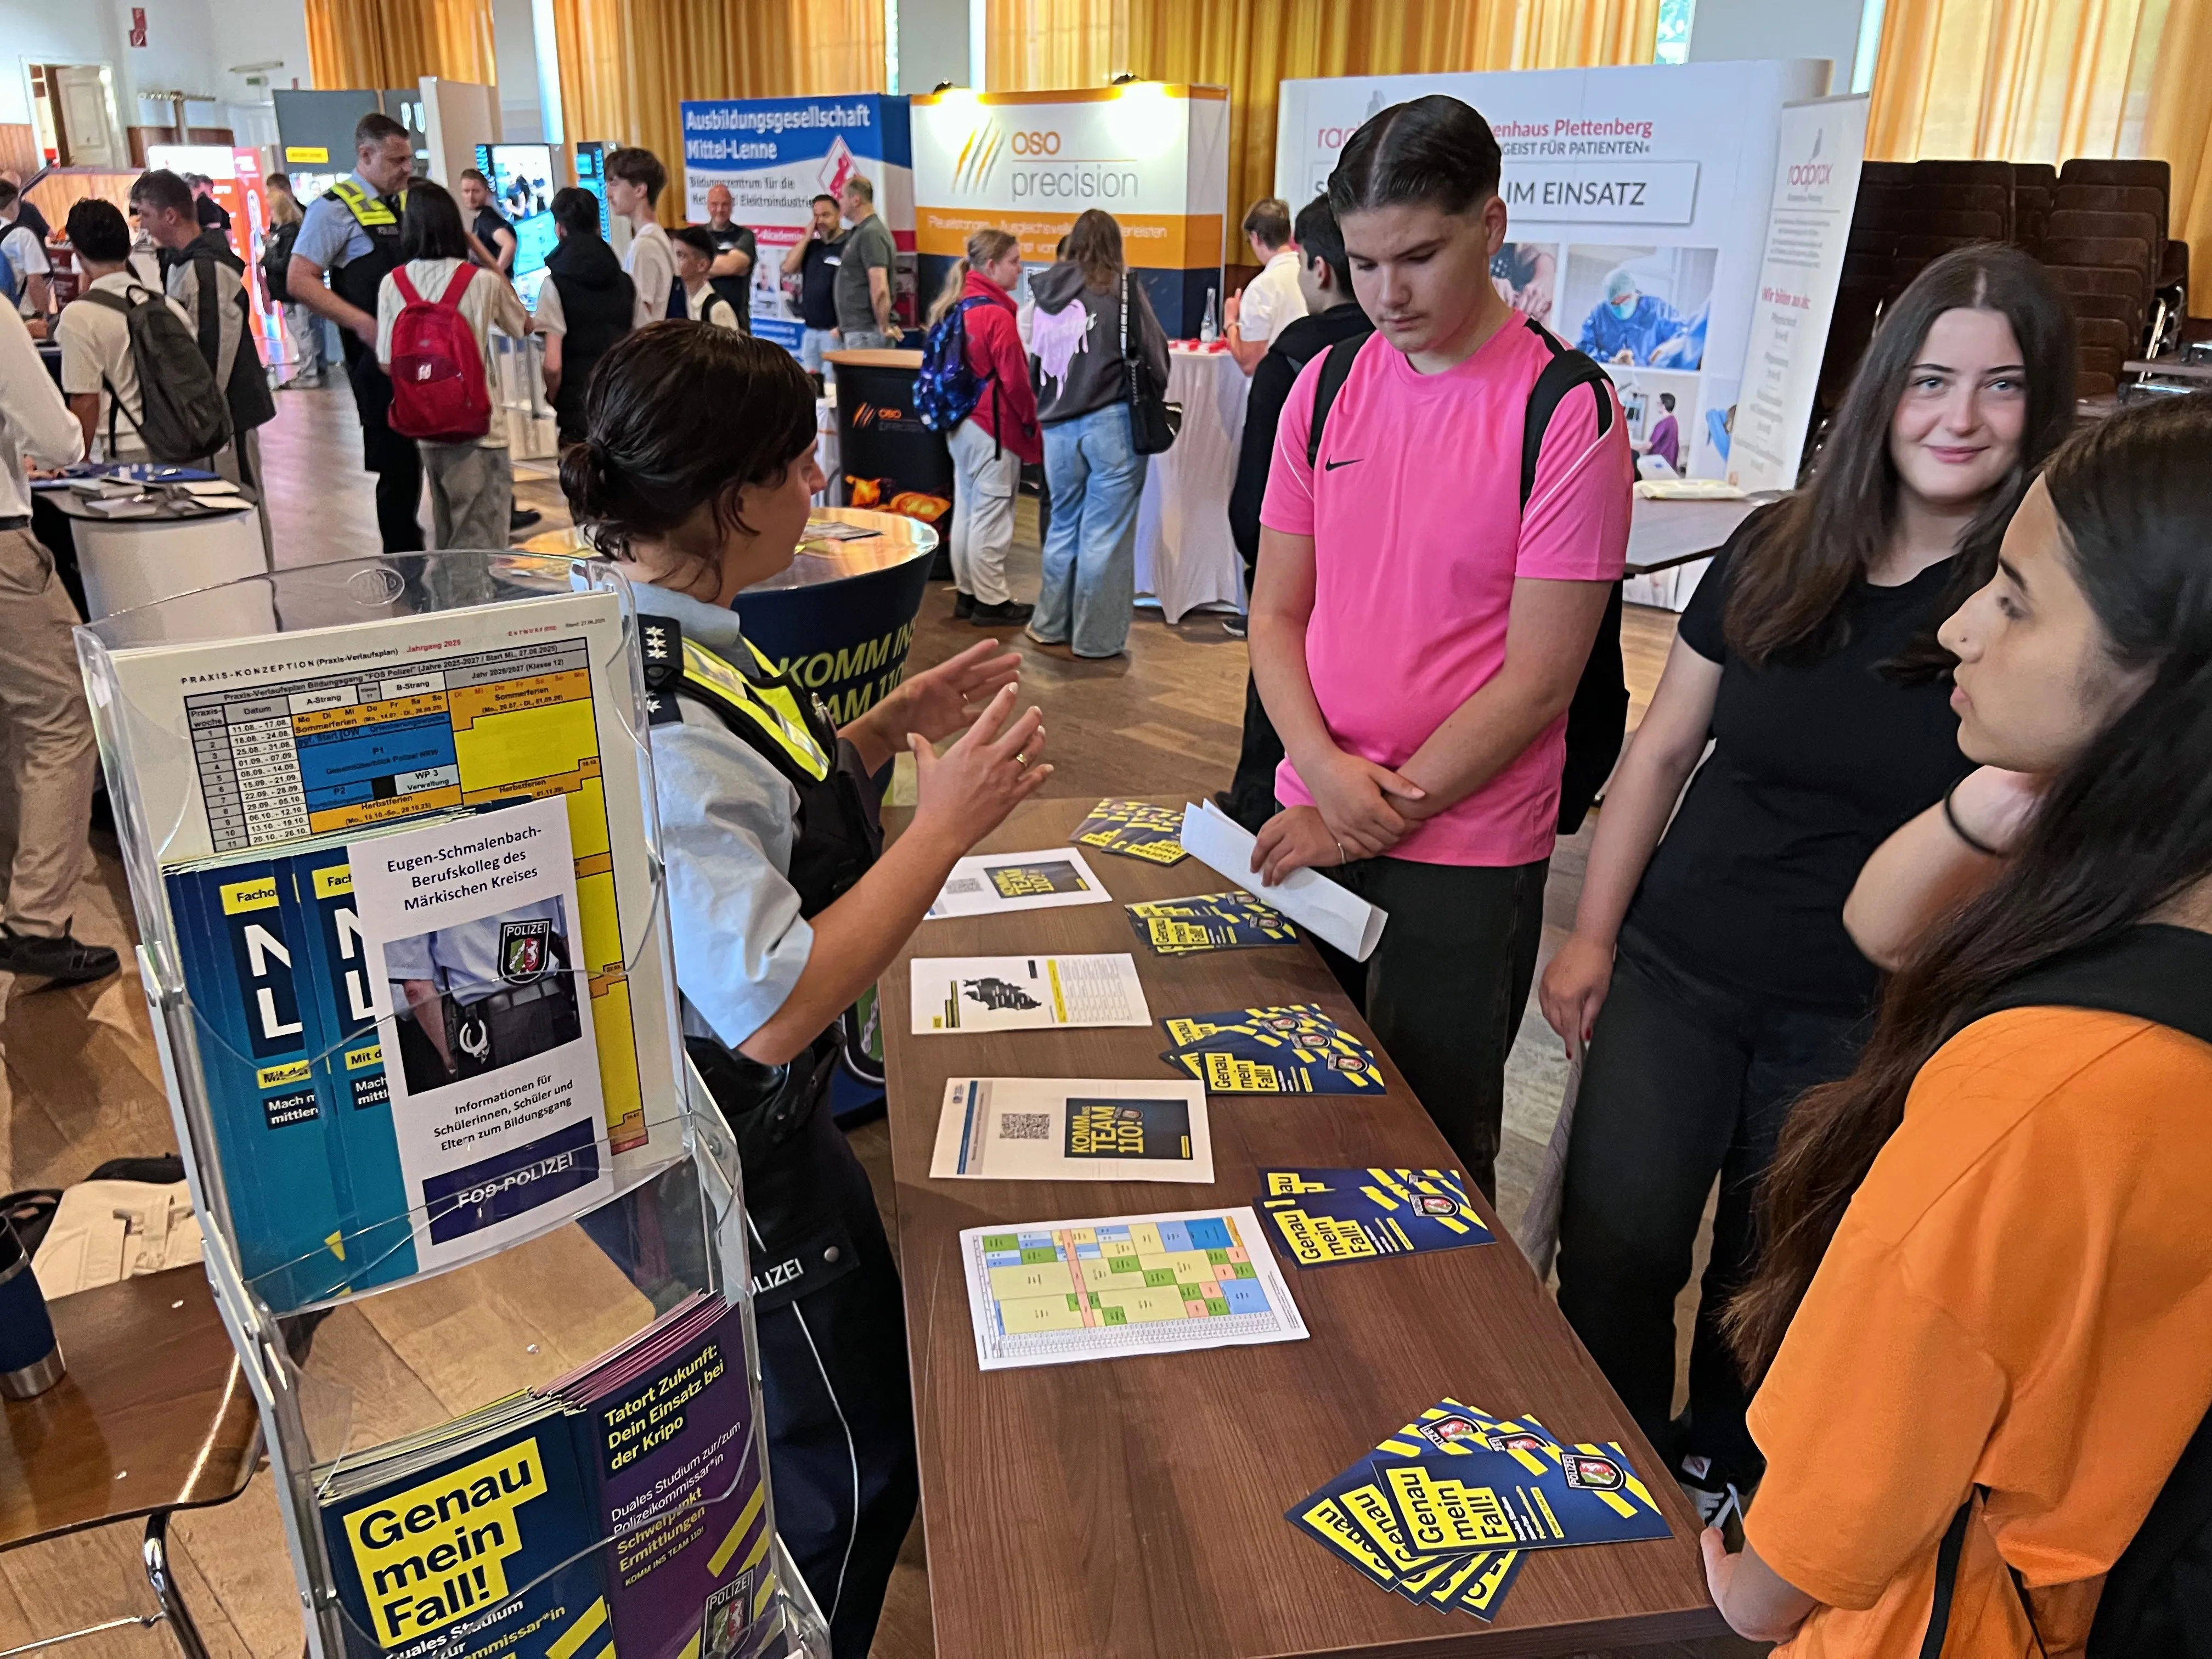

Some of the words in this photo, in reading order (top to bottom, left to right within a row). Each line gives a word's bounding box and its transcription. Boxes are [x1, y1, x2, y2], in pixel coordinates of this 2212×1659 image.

[686, 104, 871, 134] Ausbildungsgesellschaft
[1493, 120, 1549, 138] enhaus
[1554, 117, 1653, 138] Plettenberg
[686, 137, 777, 160] Mittel-Lenne
[1011, 131, 1061, 156] oso
[1503, 142, 1537, 155] GEIST
[1540, 139, 1565, 155] FÜR
[765, 176, 779, 189] für
[781, 178, 795, 190] die
[1012, 165, 1138, 202] precision
[1506, 181, 1534, 205] IM
[1542, 182, 1647, 205] EINSATZ
[317, 647, 399, 667] (Praxis-Verlaufsplan)
[778, 633, 892, 690] KOMM
[224, 684, 306, 702] Praxis-Verlaufsplan
[308, 674, 363, 690] Bildungsgang
[419, 663, 442, 674] (Jahre
[396, 681, 430, 691] B-Strang
[471, 670, 488, 679] Jahr
[244, 705, 272, 715] Datum
[306, 694, 342, 706] A-Strang
[494, 687, 549, 702] Sommerferien
[826, 682, 873, 725] AM
[191, 708, 222, 718] Praxis-
[193, 718, 223, 729] woche
[295, 718, 358, 734] Sommerferien
[332, 786, 347, 795] P2
[407, 778, 450, 792] Verwaltung
[415, 771, 430, 781] WP
[499, 779, 546, 794] Herbstferien
[361, 795, 413, 811] Herbstferien
[387, 825, 543, 872] Eugen-Schmalenbach-
[411, 856, 501, 888] Berufskolleg
[503, 849, 527, 866] des
[236, 887, 279, 905] Facho
[404, 878, 488, 911] Märkischen
[491, 866, 538, 889] Kreises
[506, 923, 546, 937] POLIZEI
[351, 1053, 372, 1065] Mit
[1213, 1055, 1232, 1089] Genau
[1233, 1063, 1254, 1089] mein
[269, 1096, 304, 1111] Mach
[358, 1088, 388, 1105] mittl
[433, 1106, 511, 1138] Schülerinnen,
[513, 1089, 552, 1110] Schüler
[554, 1079, 574, 1094] und
[454, 1080, 534, 1115] Informationen
[537, 1073, 552, 1087] für
[271, 1108, 318, 1125] mittler
[441, 1134, 475, 1152] Eltern
[478, 1124, 502, 1139] zum
[503, 1097, 572, 1130] Bildungsgang
[1091, 1105, 1116, 1154] TEAM
[1071, 1115, 1091, 1153] KOMM
[1117, 1120, 1144, 1154] 110!
[1284, 1214, 1322, 1260] Genau
[1314, 1221, 1347, 1257] mein
[1339, 1225, 1371, 1254] Fall!
[603, 1387, 656, 1427] Tatort
[658, 1344, 718, 1397] Zukunft:
[608, 1418, 646, 1449] Dein
[648, 1379, 702, 1425] Einsatz
[704, 1359, 724, 1386] bei
[611, 1444, 639, 1470] der
[642, 1415, 684, 1452] Kripo
[611, 1489, 653, 1522] Duales
[654, 1454, 702, 1494] Studium
[702, 1421, 741, 1460] zur/zum
[1565, 1456, 1581, 1486] POLIZEI
[359, 1459, 532, 1550] Genau
[617, 1486, 703, 1555] Schwerpunkt
[1399, 1473, 1444, 1544] Genau
[1437, 1486, 1477, 1542] mein
[1469, 1493, 1509, 1539] Fall!
[619, 1506, 706, 1573] Ermittlungen
[373, 1521, 505, 1596] mein
[625, 1565, 652, 1587] KOMM
[667, 1538, 690, 1558] TEAM
[383, 1565, 491, 1639] Fall!
[709, 1574, 751, 1611] POLIZEI
